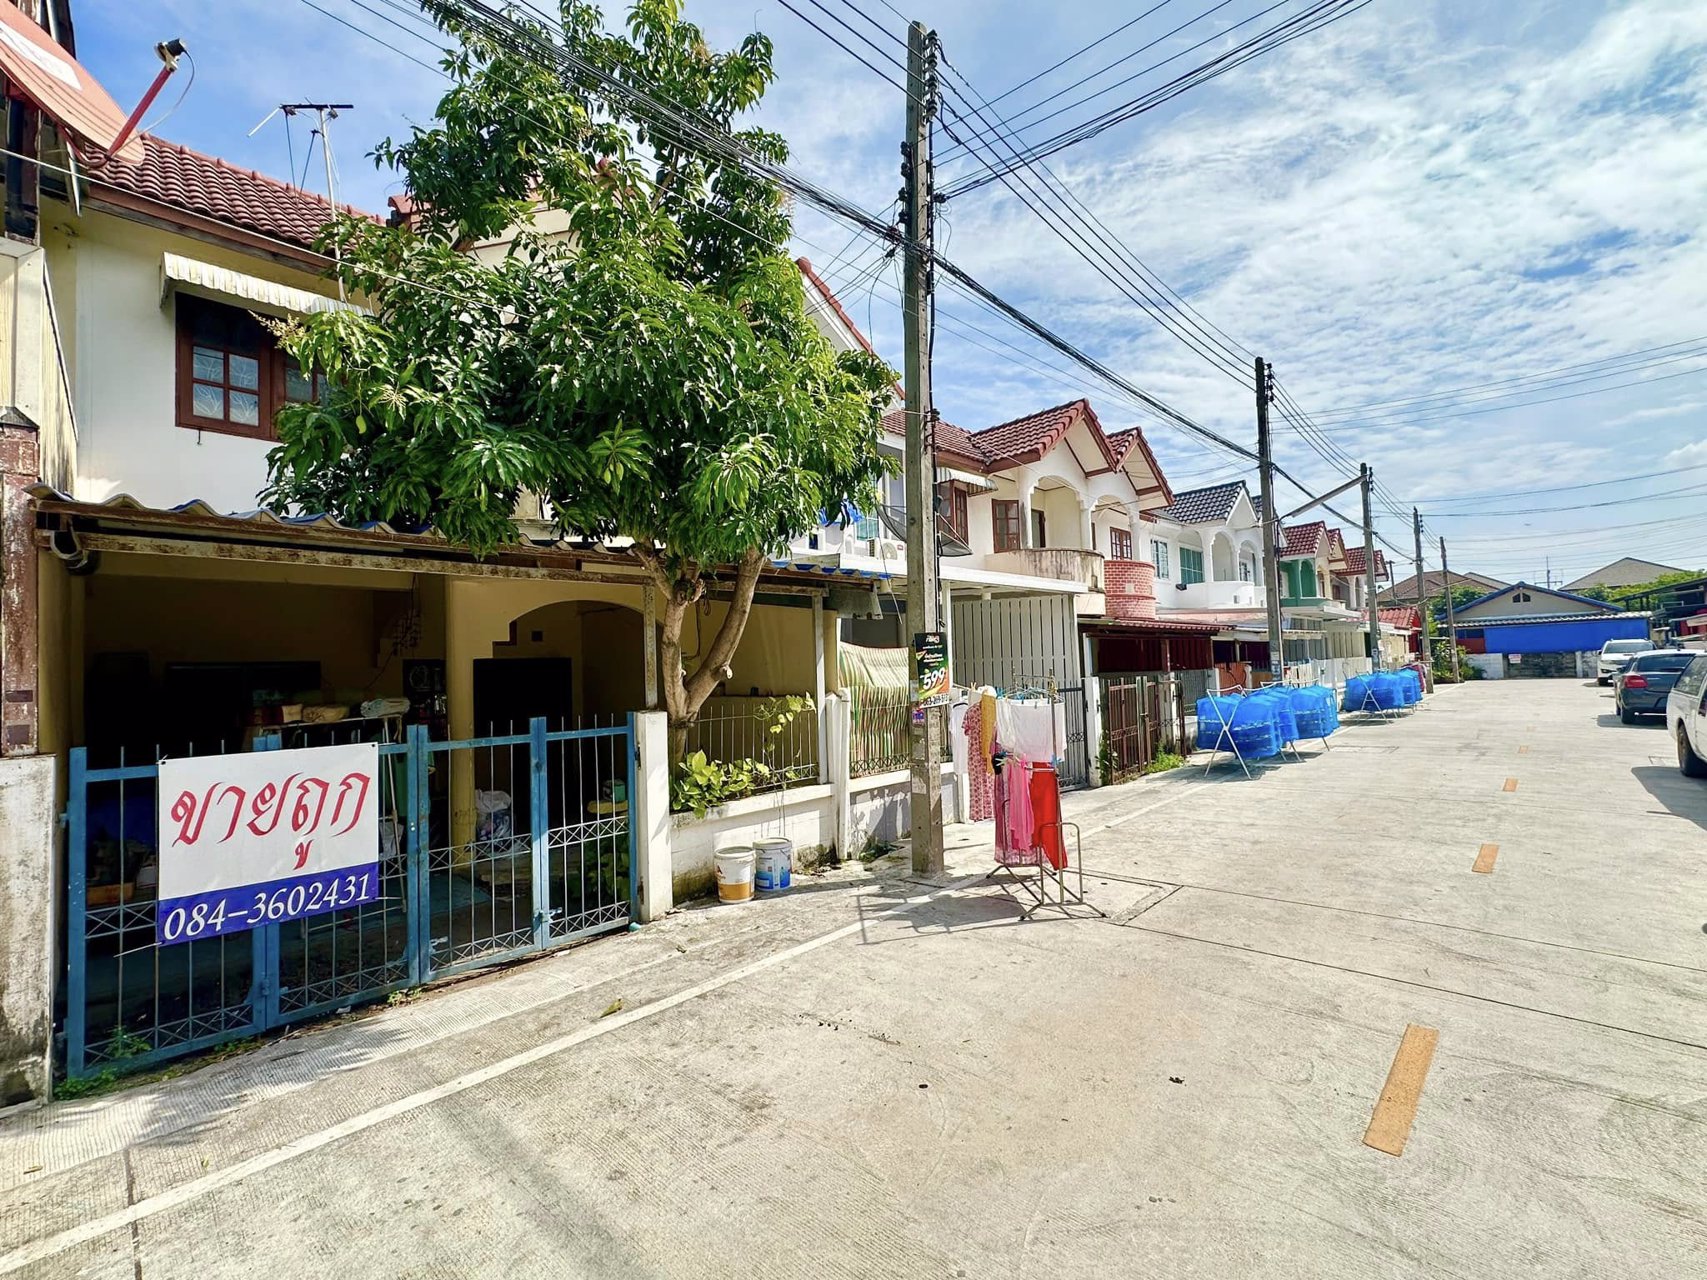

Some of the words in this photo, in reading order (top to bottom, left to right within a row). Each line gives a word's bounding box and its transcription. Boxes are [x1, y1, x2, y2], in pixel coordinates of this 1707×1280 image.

[921, 667, 945, 690] 599
[170, 771, 371, 870] ขายถูก
[163, 872, 370, 941] 084-3602431
